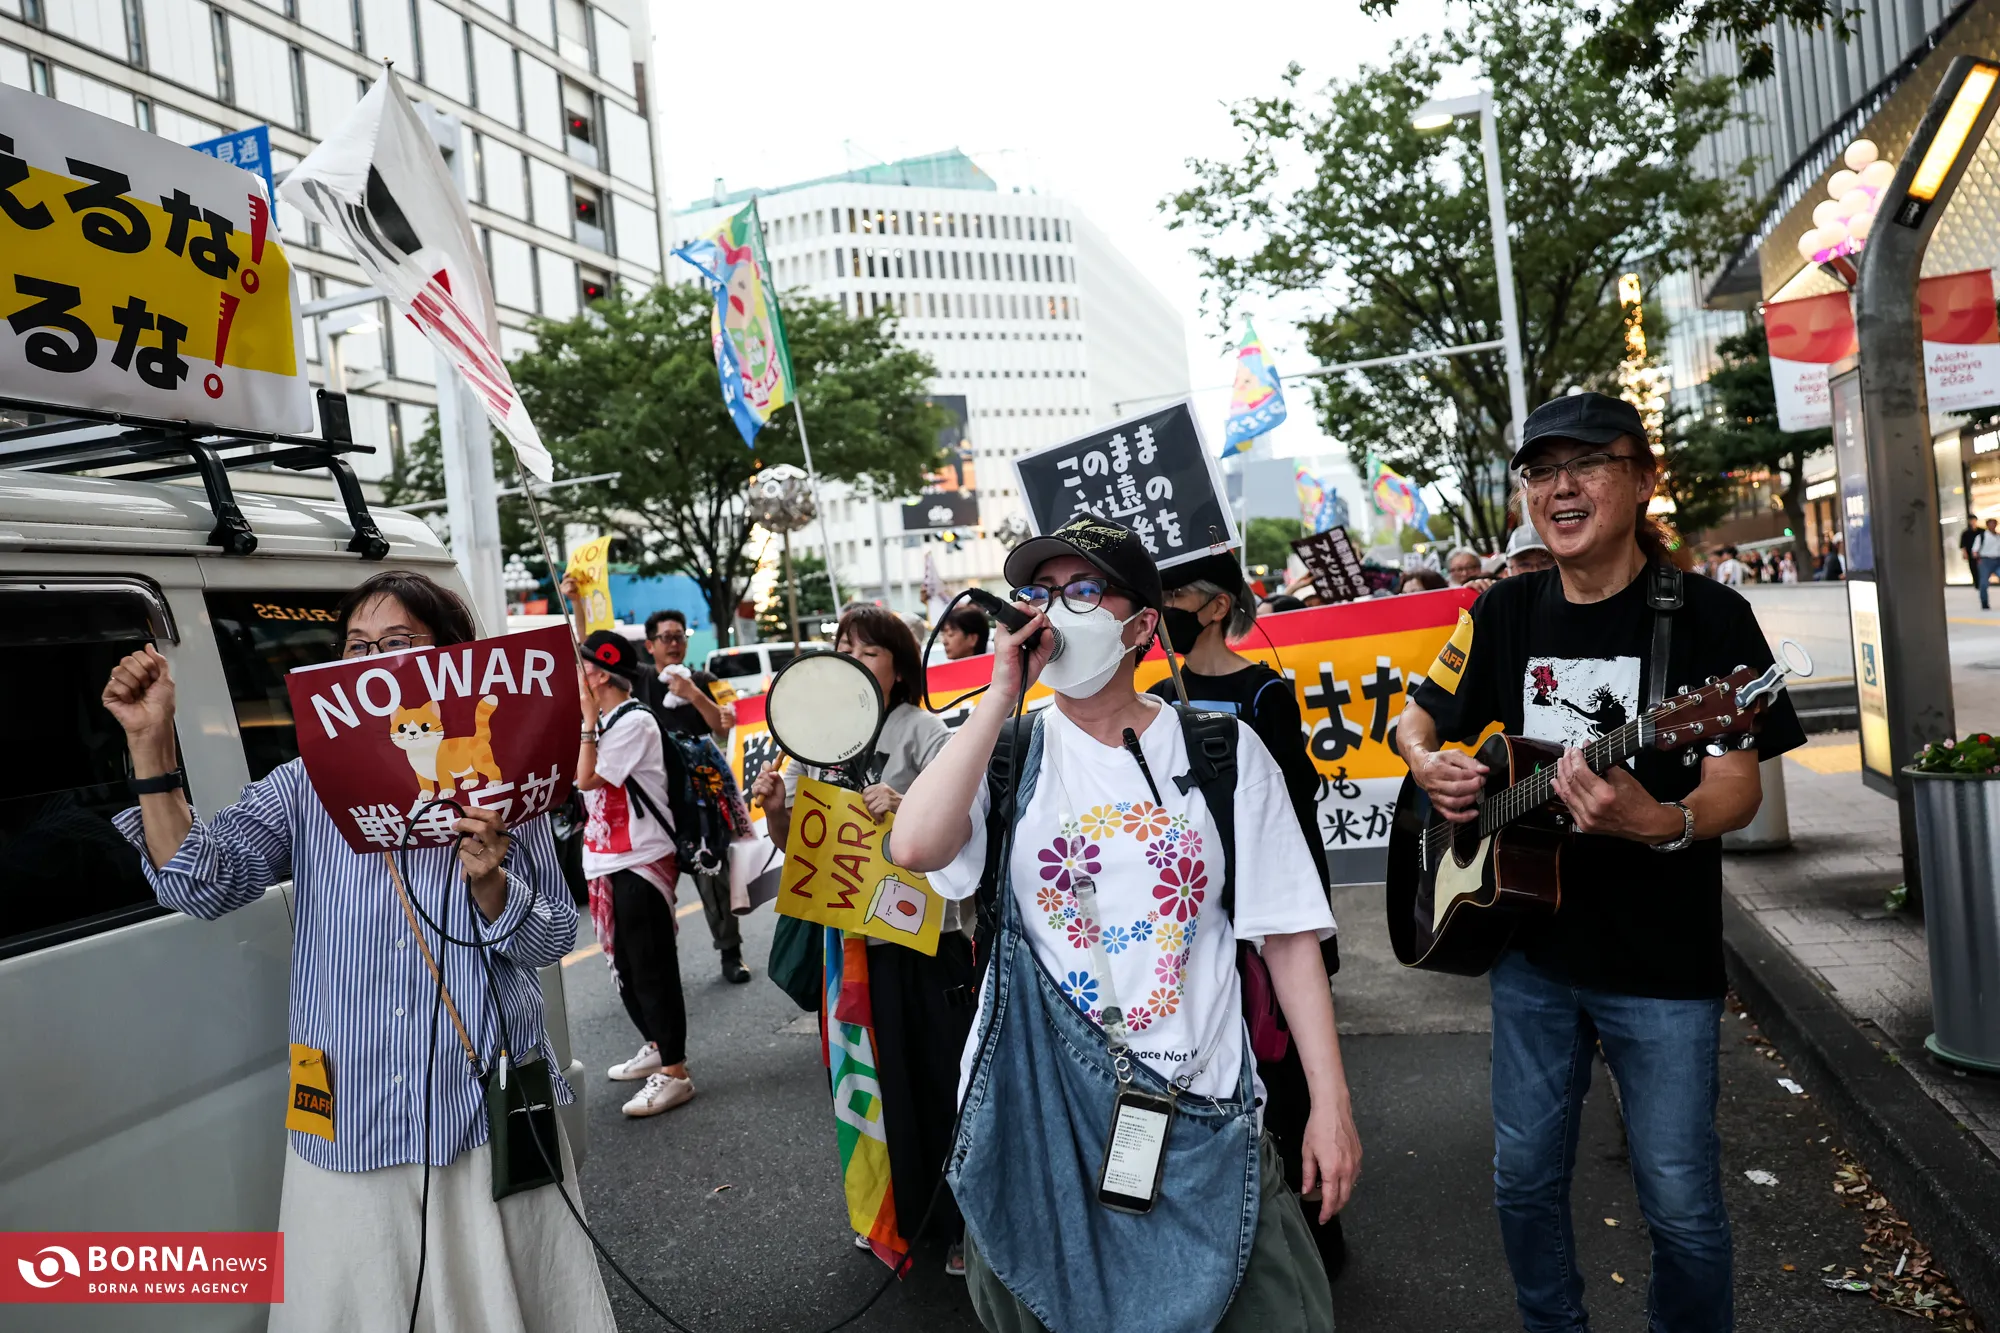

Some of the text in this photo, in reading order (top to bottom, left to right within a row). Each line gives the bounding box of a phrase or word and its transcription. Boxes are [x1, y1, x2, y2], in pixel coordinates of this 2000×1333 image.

[202, 135, 260, 166] 見通
[7, 273, 240, 399] るな!
[1804, 393, 1828, 405] 202
[1056, 424, 1158, 487] このまま
[1132, 508, 1184, 554] 後を
[1315, 539, 1351, 596] アメリカに
[310, 648, 556, 739] NO WAR
[790, 790, 831, 899] NO!
[826, 803, 878, 909] WAR!
[1163, 1050, 1188, 1062] Not
[296, 1091, 331, 1114] STAFF
